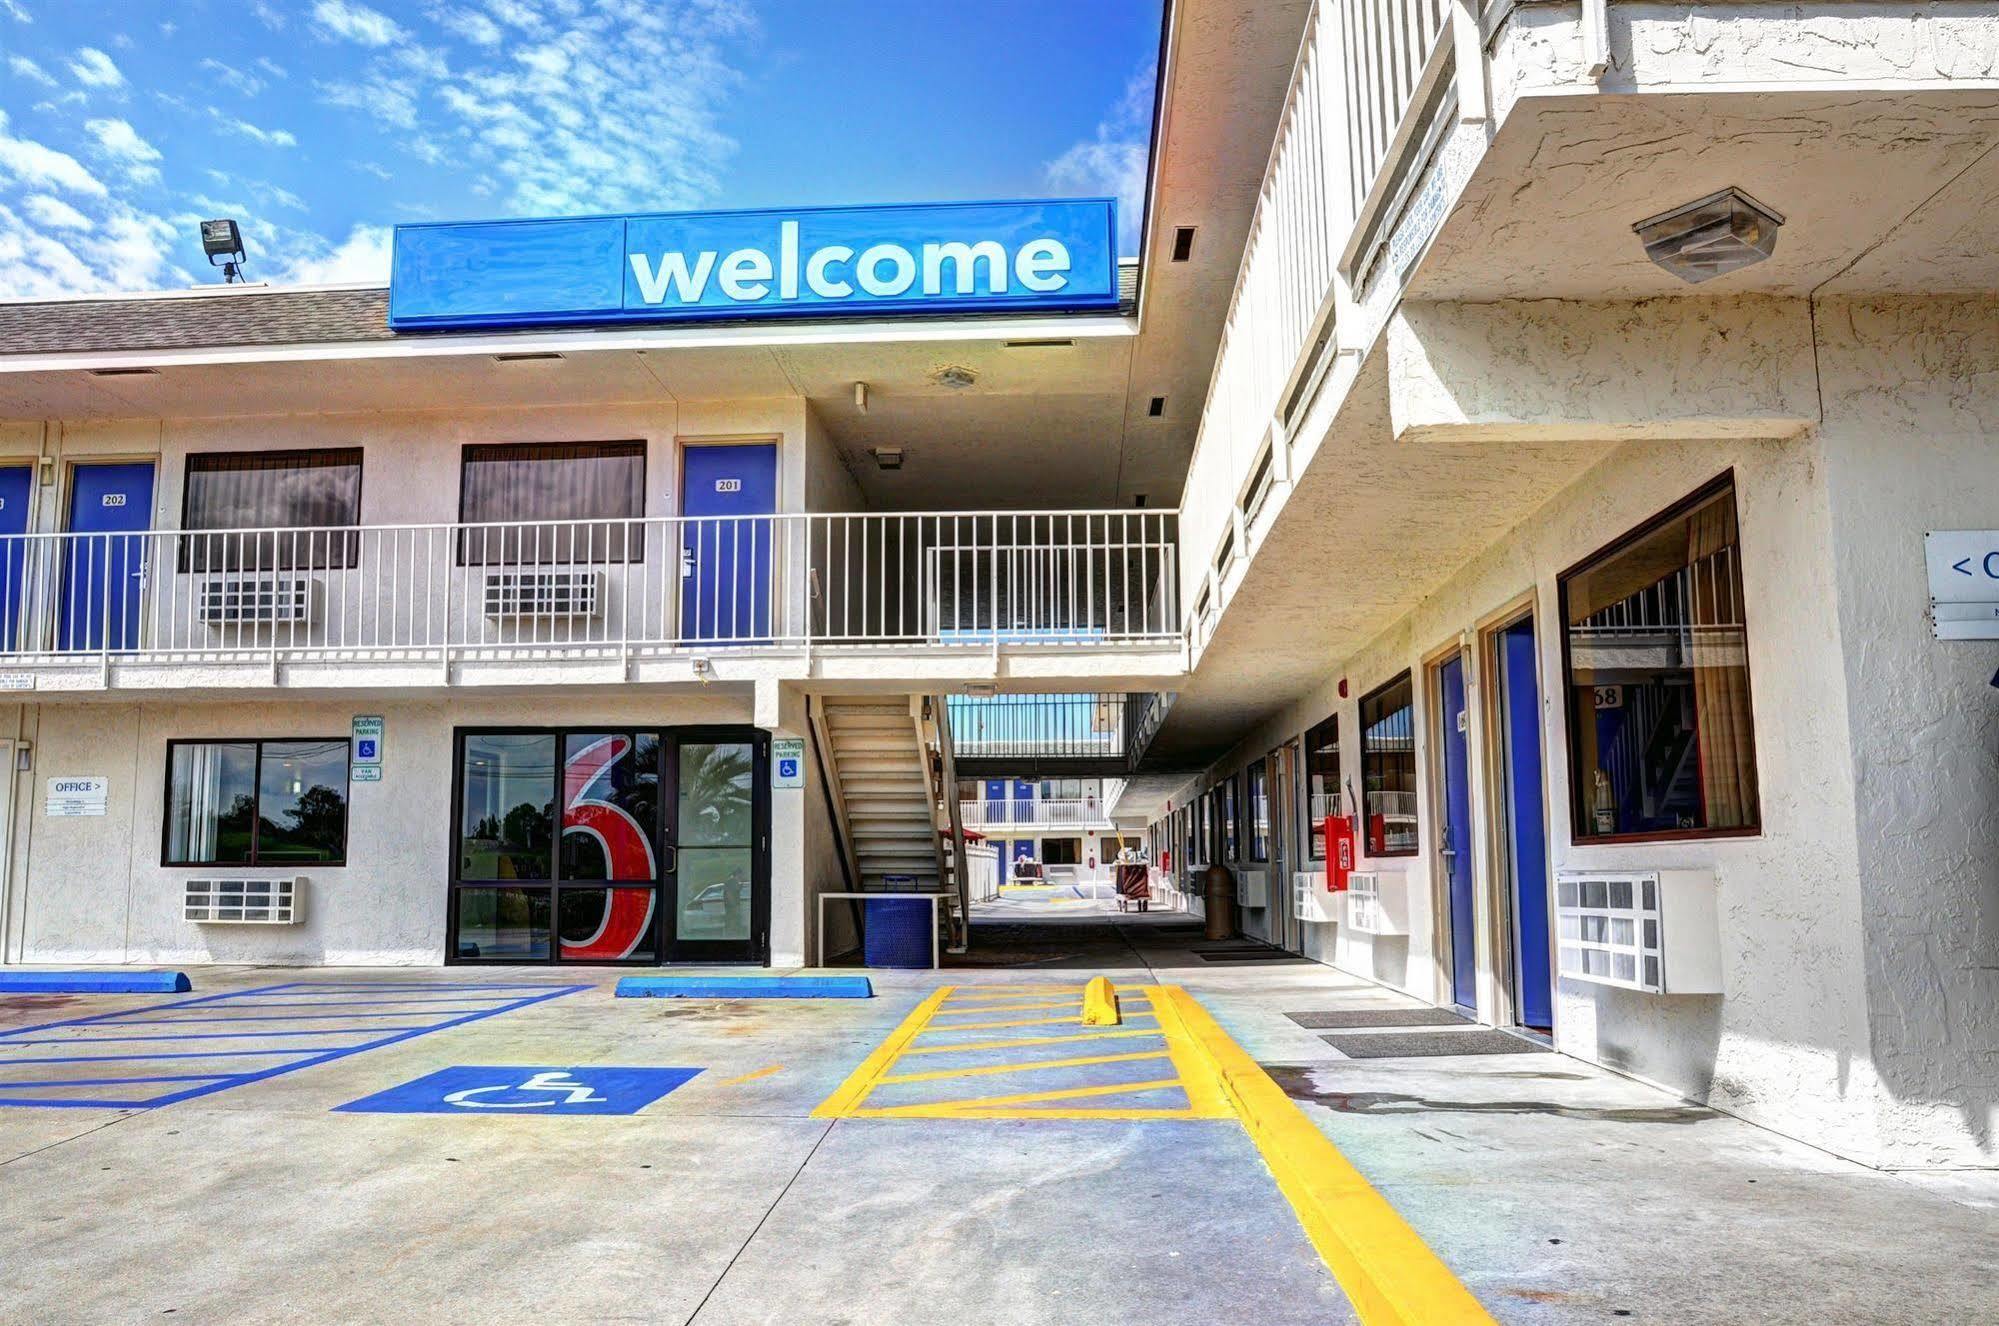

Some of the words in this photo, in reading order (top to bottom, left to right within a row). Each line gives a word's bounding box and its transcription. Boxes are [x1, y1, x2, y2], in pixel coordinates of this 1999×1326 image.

[629, 221, 1072, 304] welcome
[719, 480, 737, 490] 201
[105, 495, 123, 504] 202
[774, 742, 803, 750] RESERVED
[56, 782, 92, 792] OFFICE
[558, 735, 657, 960] 6
